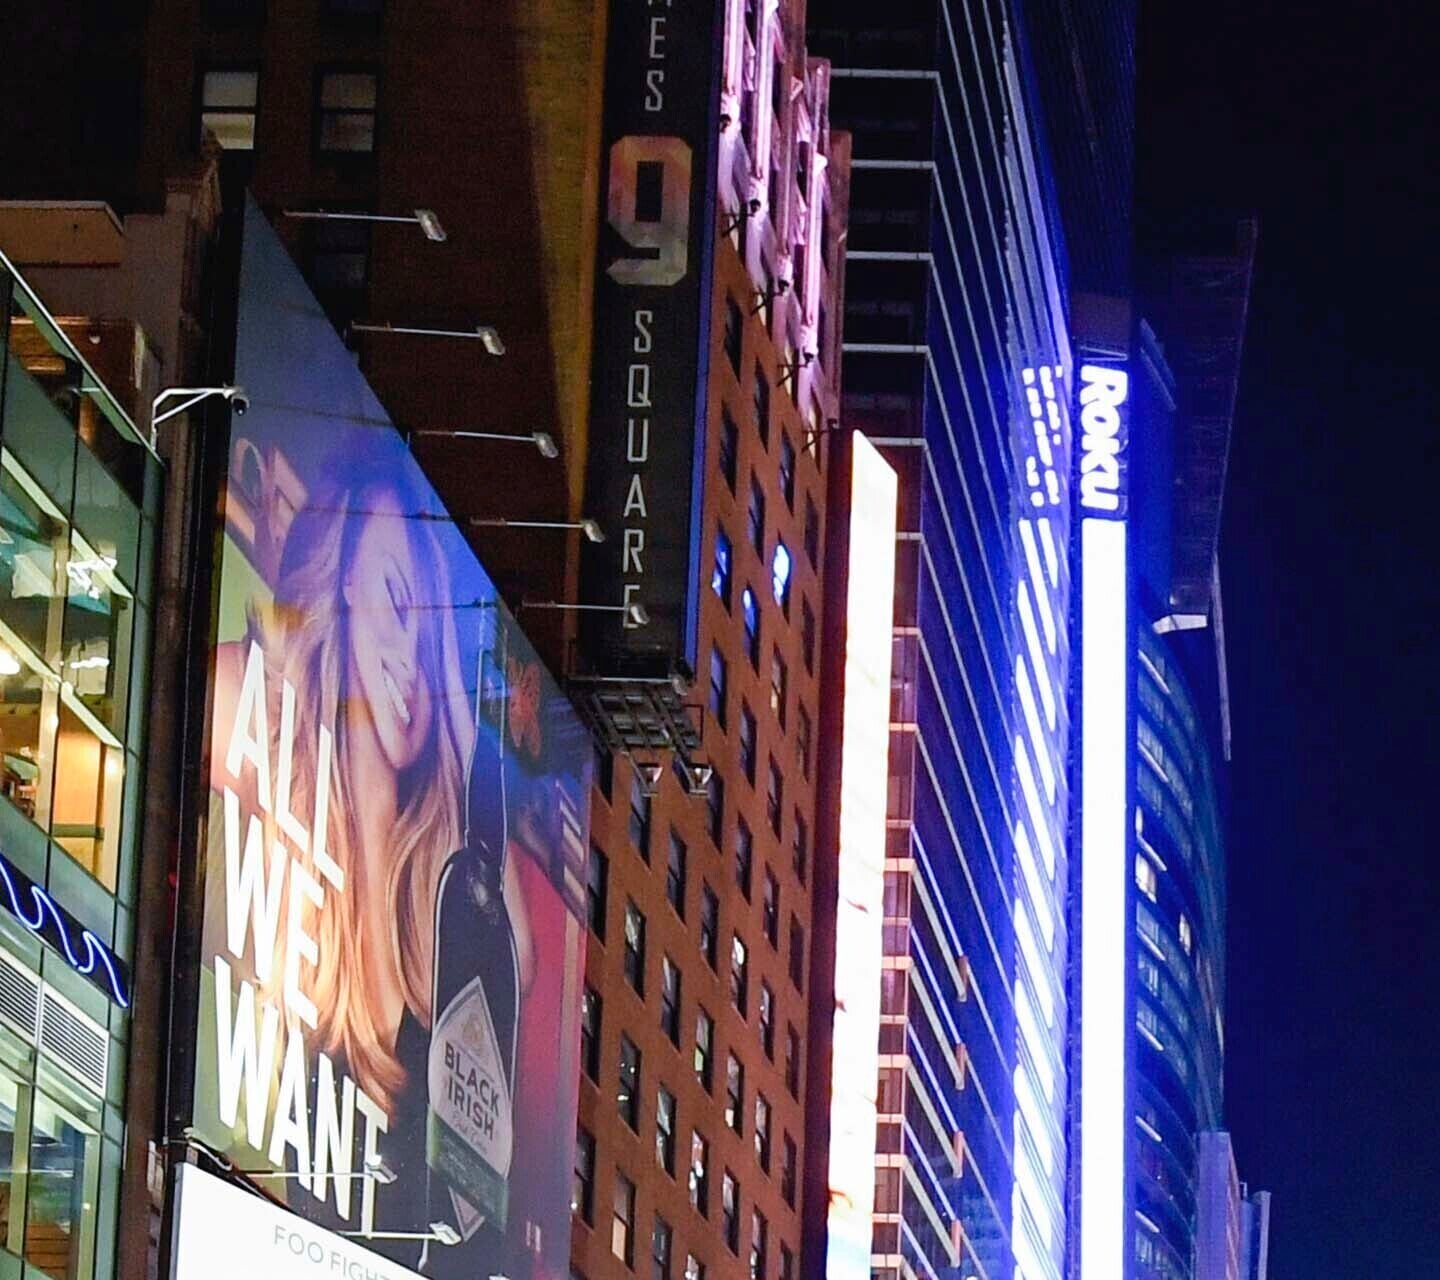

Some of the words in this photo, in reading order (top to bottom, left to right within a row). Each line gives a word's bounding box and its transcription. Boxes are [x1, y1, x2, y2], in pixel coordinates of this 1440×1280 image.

[645, 0, 668, 112] ES
[606, 135, 693, 285] 9
[623, 310, 653, 629] SQUARE
[226, 640, 344, 892] ALL
[225, 786, 324, 1030] WE
[214, 955, 388, 1239] WANT
[444, 1041, 500, 1117] BLACK
[447, 1077, 495, 1141] IRISH
[274, 1224, 324, 1264] FOO
